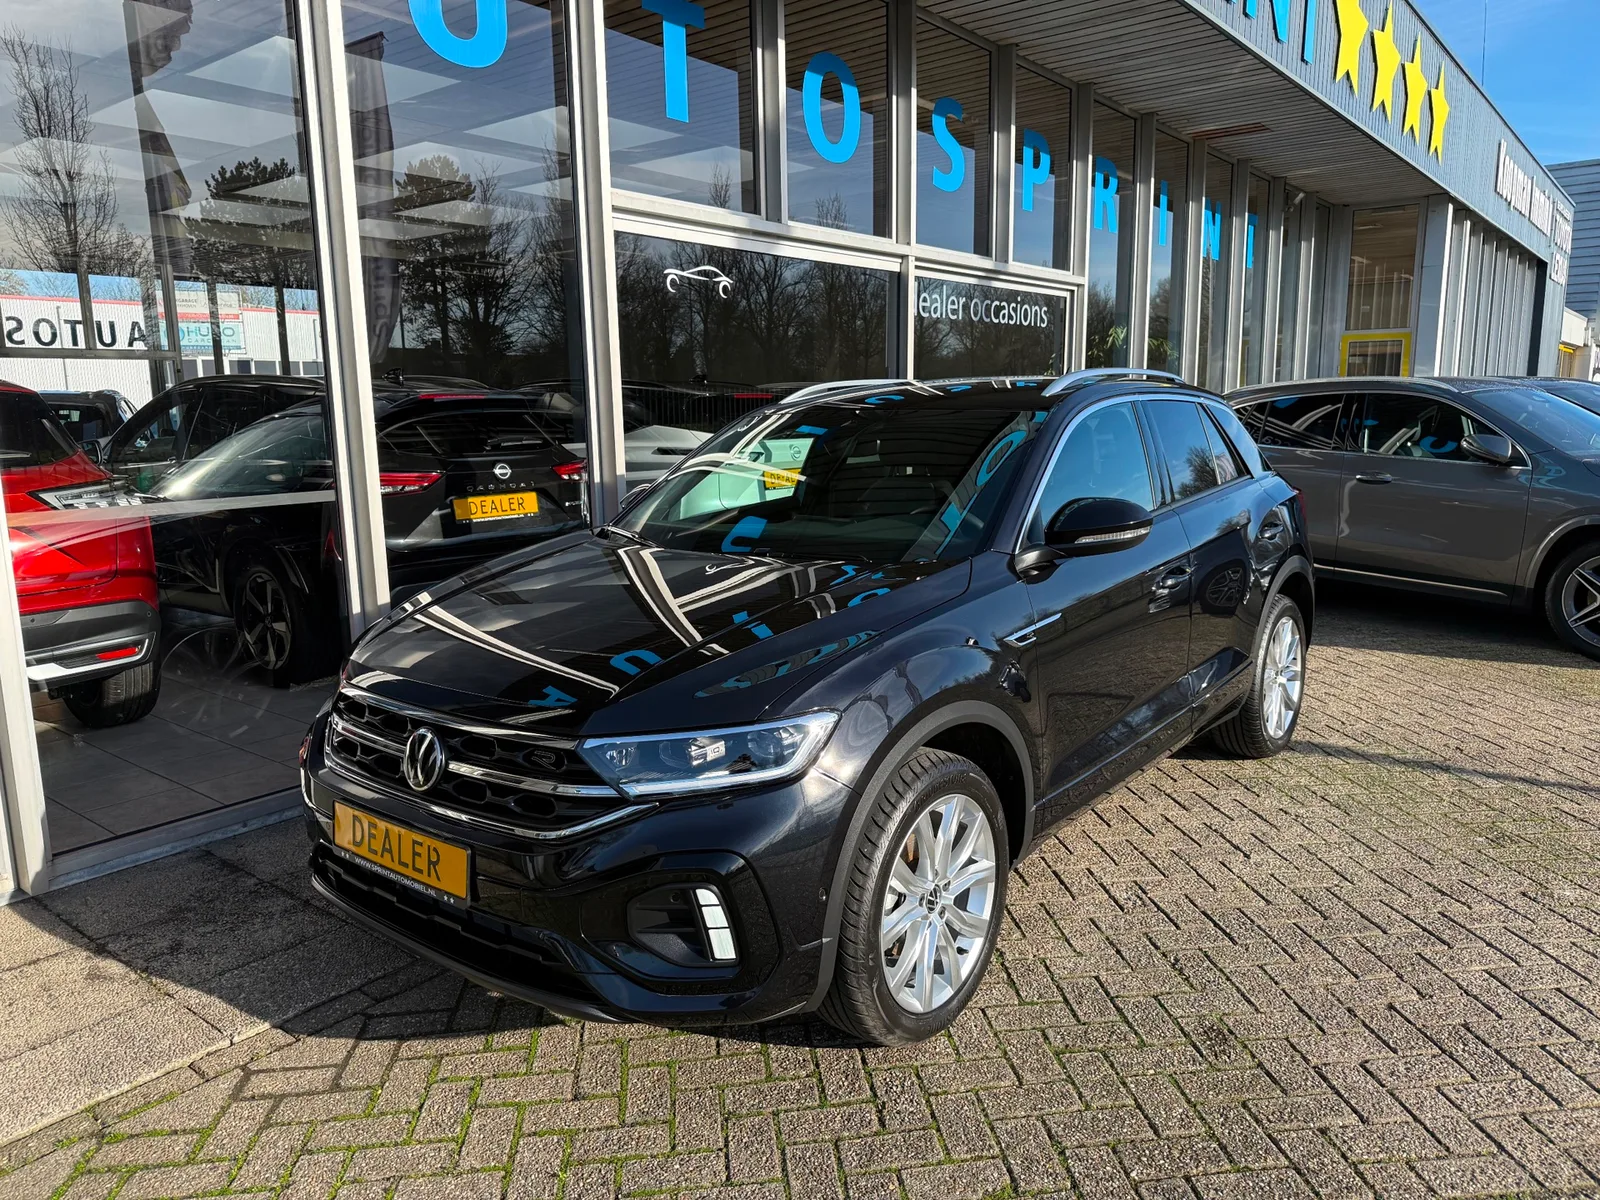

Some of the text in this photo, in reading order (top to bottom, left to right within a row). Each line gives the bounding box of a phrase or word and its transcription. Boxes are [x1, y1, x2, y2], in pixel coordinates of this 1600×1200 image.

[970, 296, 1048, 328] occasions
[186, 325, 236, 338] HUO
[469, 496, 526, 517] DEALER
[352, 813, 442, 882] DEALER
[354, 856, 437, 897] WWW.SPRINTAUTOMOBIEL.NL
